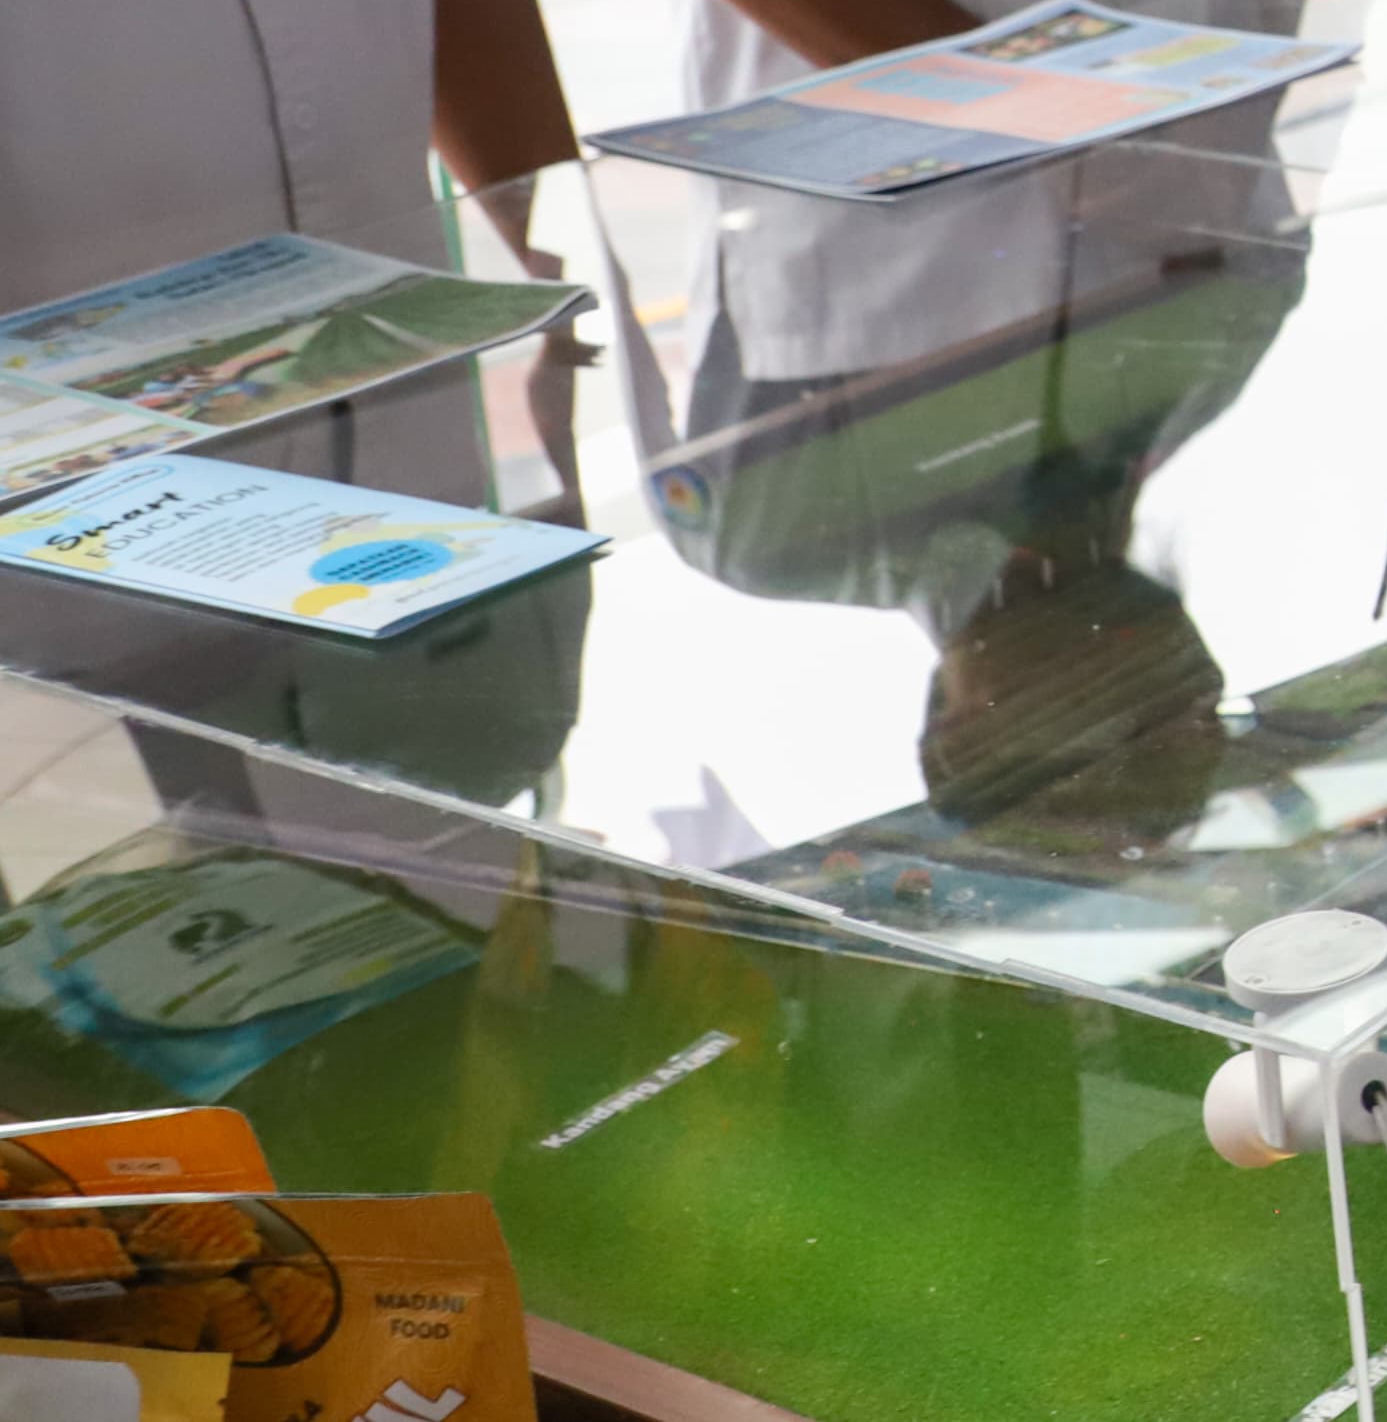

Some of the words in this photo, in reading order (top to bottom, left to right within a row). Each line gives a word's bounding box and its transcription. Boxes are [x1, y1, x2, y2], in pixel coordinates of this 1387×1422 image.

[46, 491, 184, 553] Smart
[84, 483, 269, 559] EDUCATION
[375, 1293, 465, 1314] MADANI
[390, 1318, 450, 1340] FOOD
